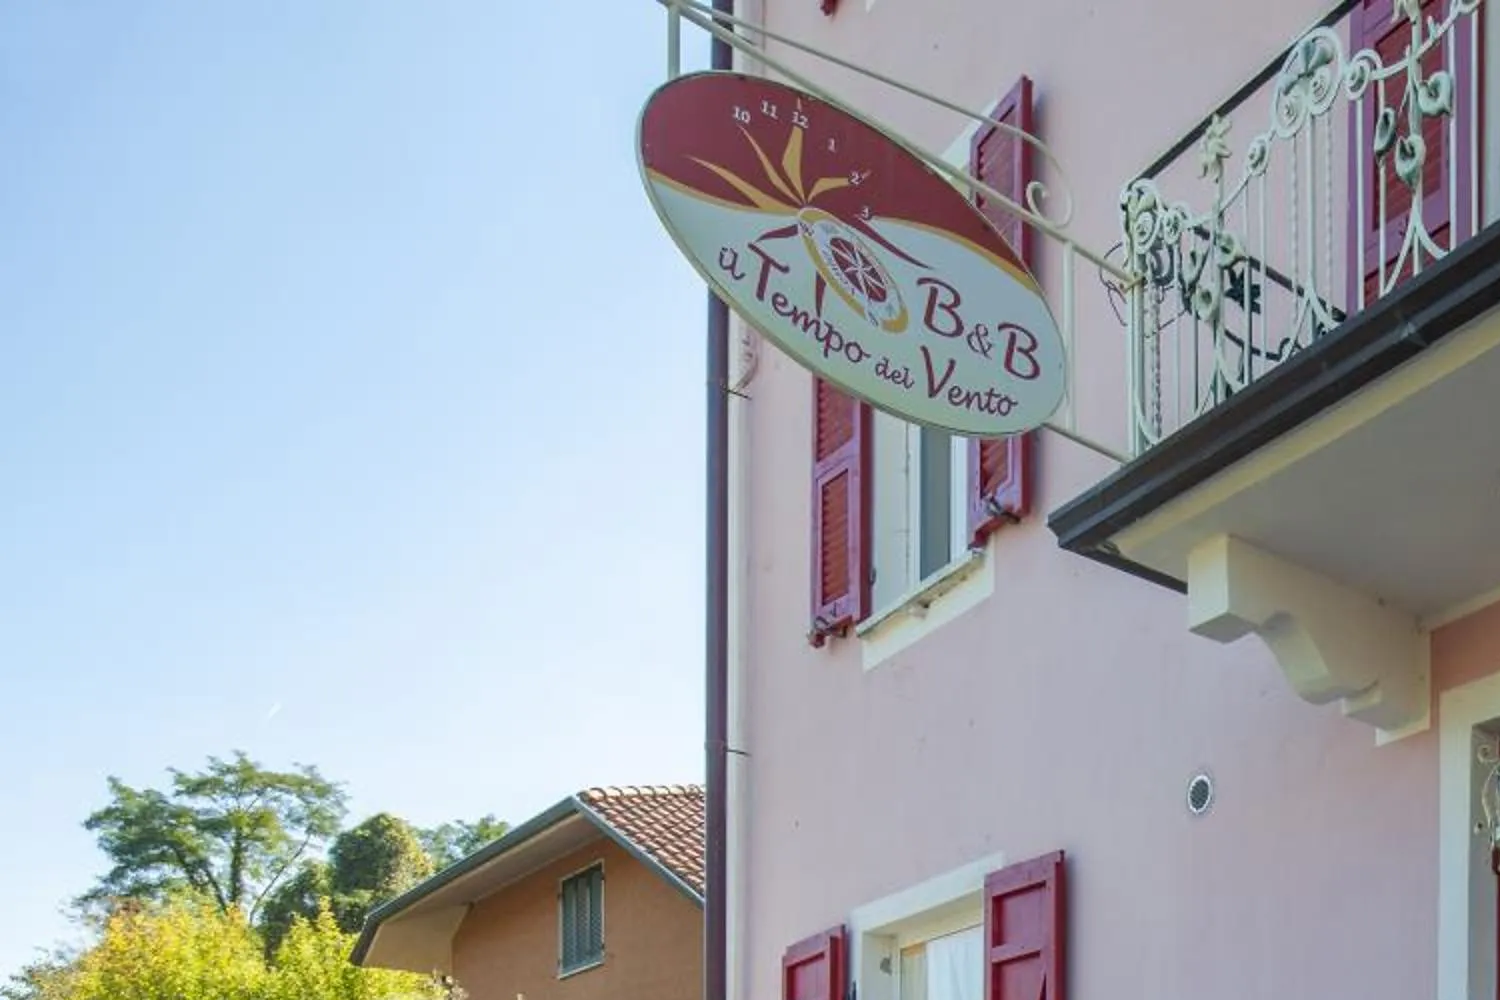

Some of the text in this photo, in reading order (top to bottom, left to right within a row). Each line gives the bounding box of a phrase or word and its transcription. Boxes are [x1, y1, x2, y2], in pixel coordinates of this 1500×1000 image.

[733, 105, 751, 124] 10
[761, 100, 779, 120] 11
[792, 111, 809, 129] 12
[828, 138, 837, 153] 1
[851, 171, 862, 186] 2
[748, 242, 871, 363] Tempo
[874, 357, 915, 390] del
[920, 345, 1019, 417] Vento
[916, 277, 1041, 381] B&B
